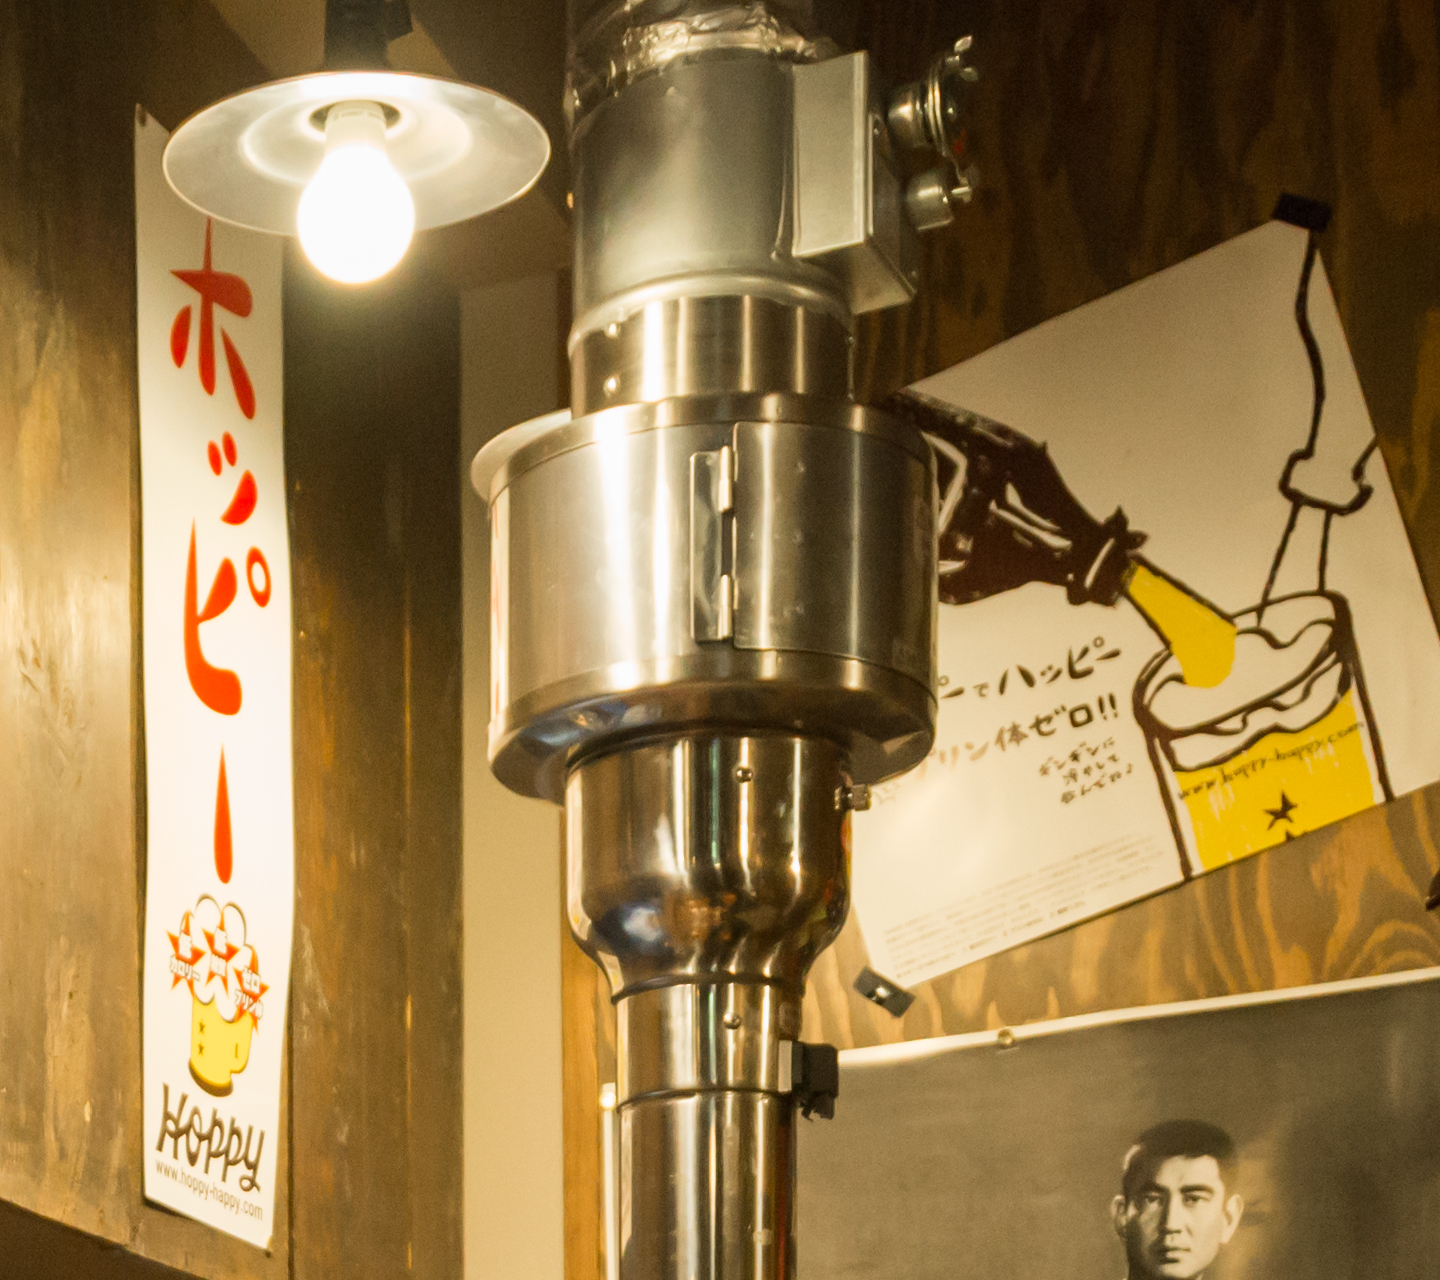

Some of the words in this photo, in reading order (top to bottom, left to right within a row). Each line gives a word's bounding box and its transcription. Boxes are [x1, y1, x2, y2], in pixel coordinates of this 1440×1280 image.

[170, 216, 272, 884] ホッピー
[937, 636, 1122, 699] ーでハッピー
